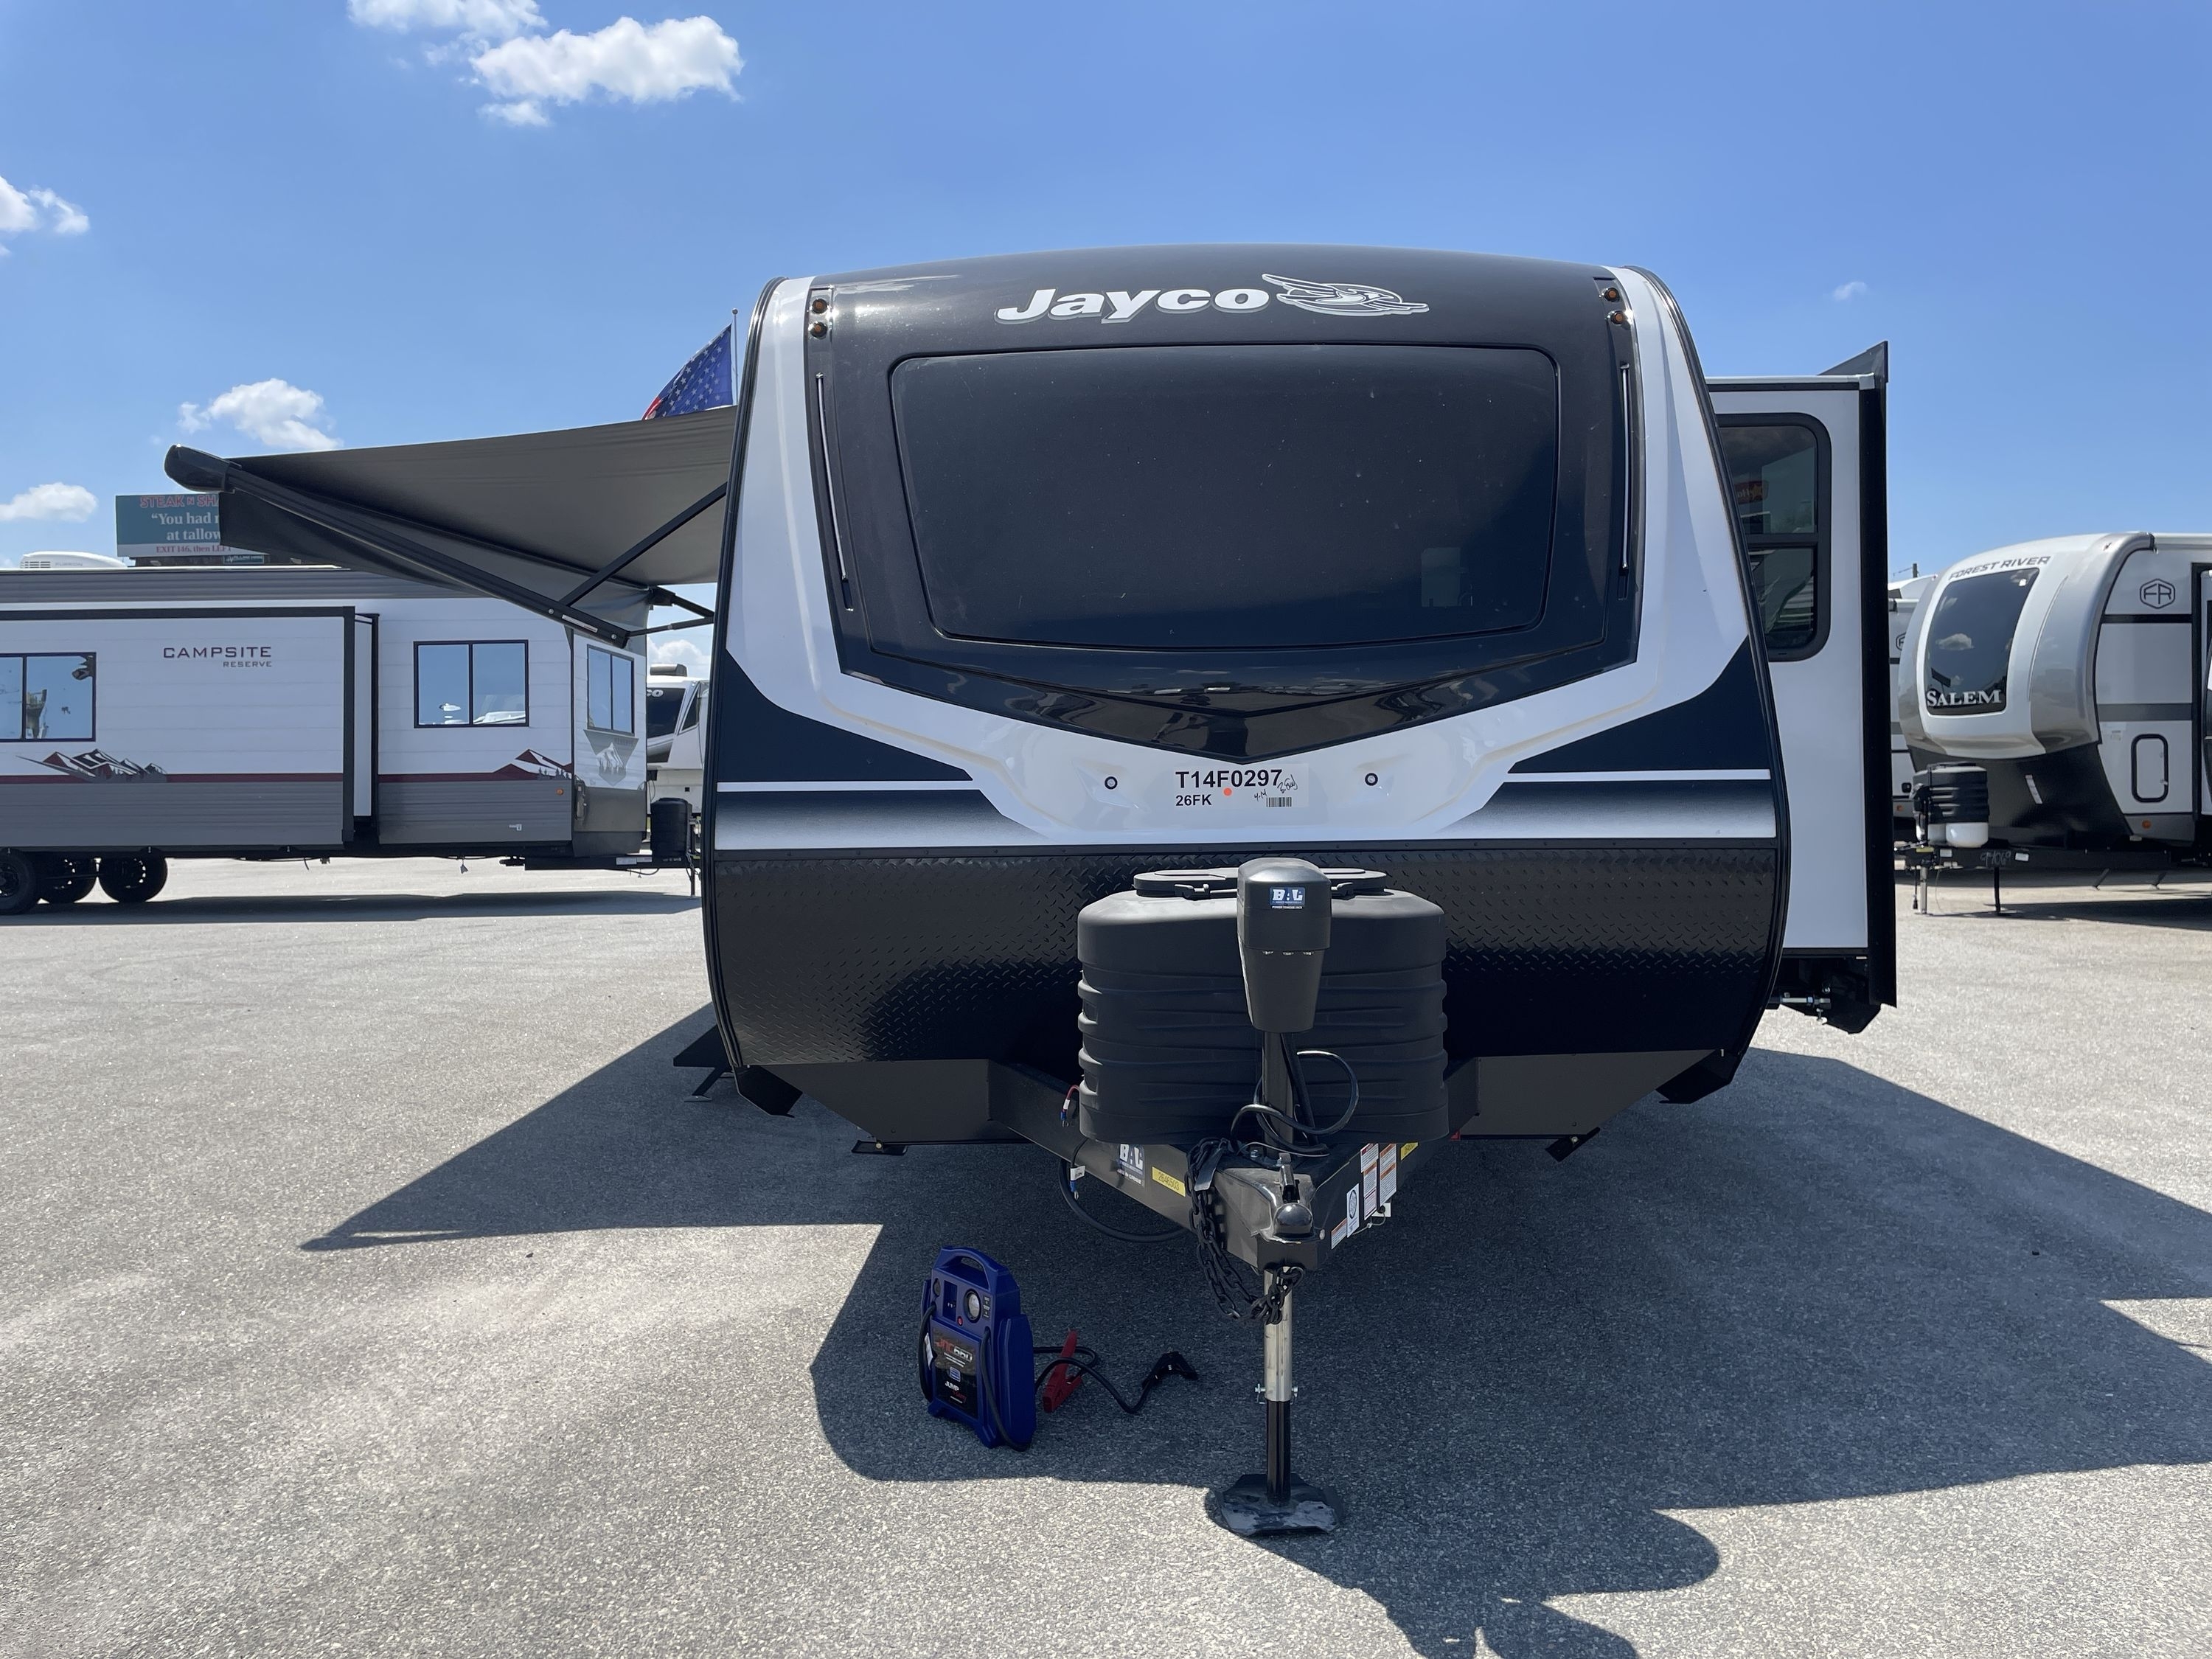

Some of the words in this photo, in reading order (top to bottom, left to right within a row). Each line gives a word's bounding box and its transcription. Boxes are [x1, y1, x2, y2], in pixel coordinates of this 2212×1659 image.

[995, 288, 1270, 324] Jayco
[139, 495, 185, 508] STEAK
[187, 512, 212, 524] had
[166, 531, 180, 540] at
[1948, 561, 2000, 580] FOREST
[2000, 556, 2051, 568] RIVER
[163, 646, 272, 658] CAMPSITE
[1926, 689, 2002, 707] SALEM
[1175, 769, 1282, 788] T14F0297
[1175, 794, 1212, 807] 26FK
